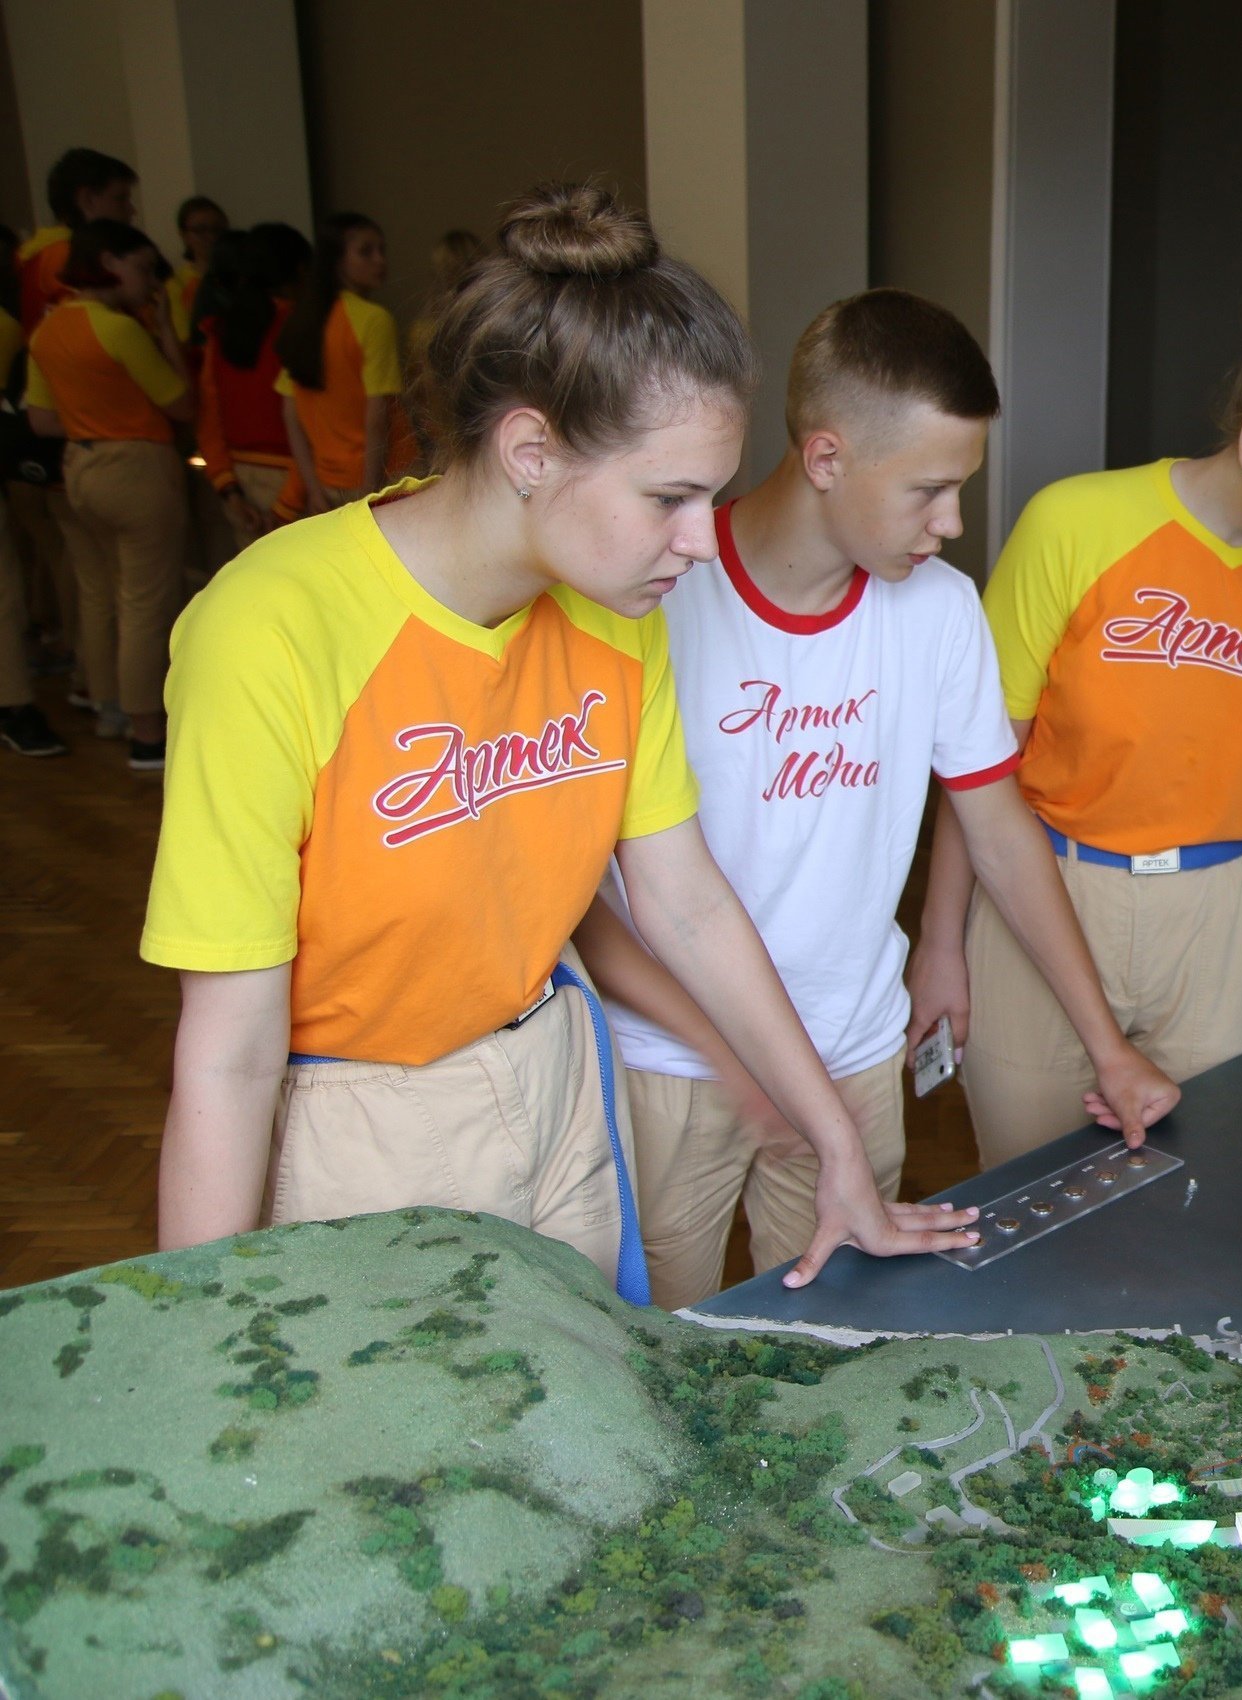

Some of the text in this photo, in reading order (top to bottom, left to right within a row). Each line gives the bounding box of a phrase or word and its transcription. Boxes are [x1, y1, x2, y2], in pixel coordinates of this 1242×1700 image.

[718, 680, 878, 744] Артек
[373, 689, 618, 836] Артек
[762, 742, 881, 802] Медиа
